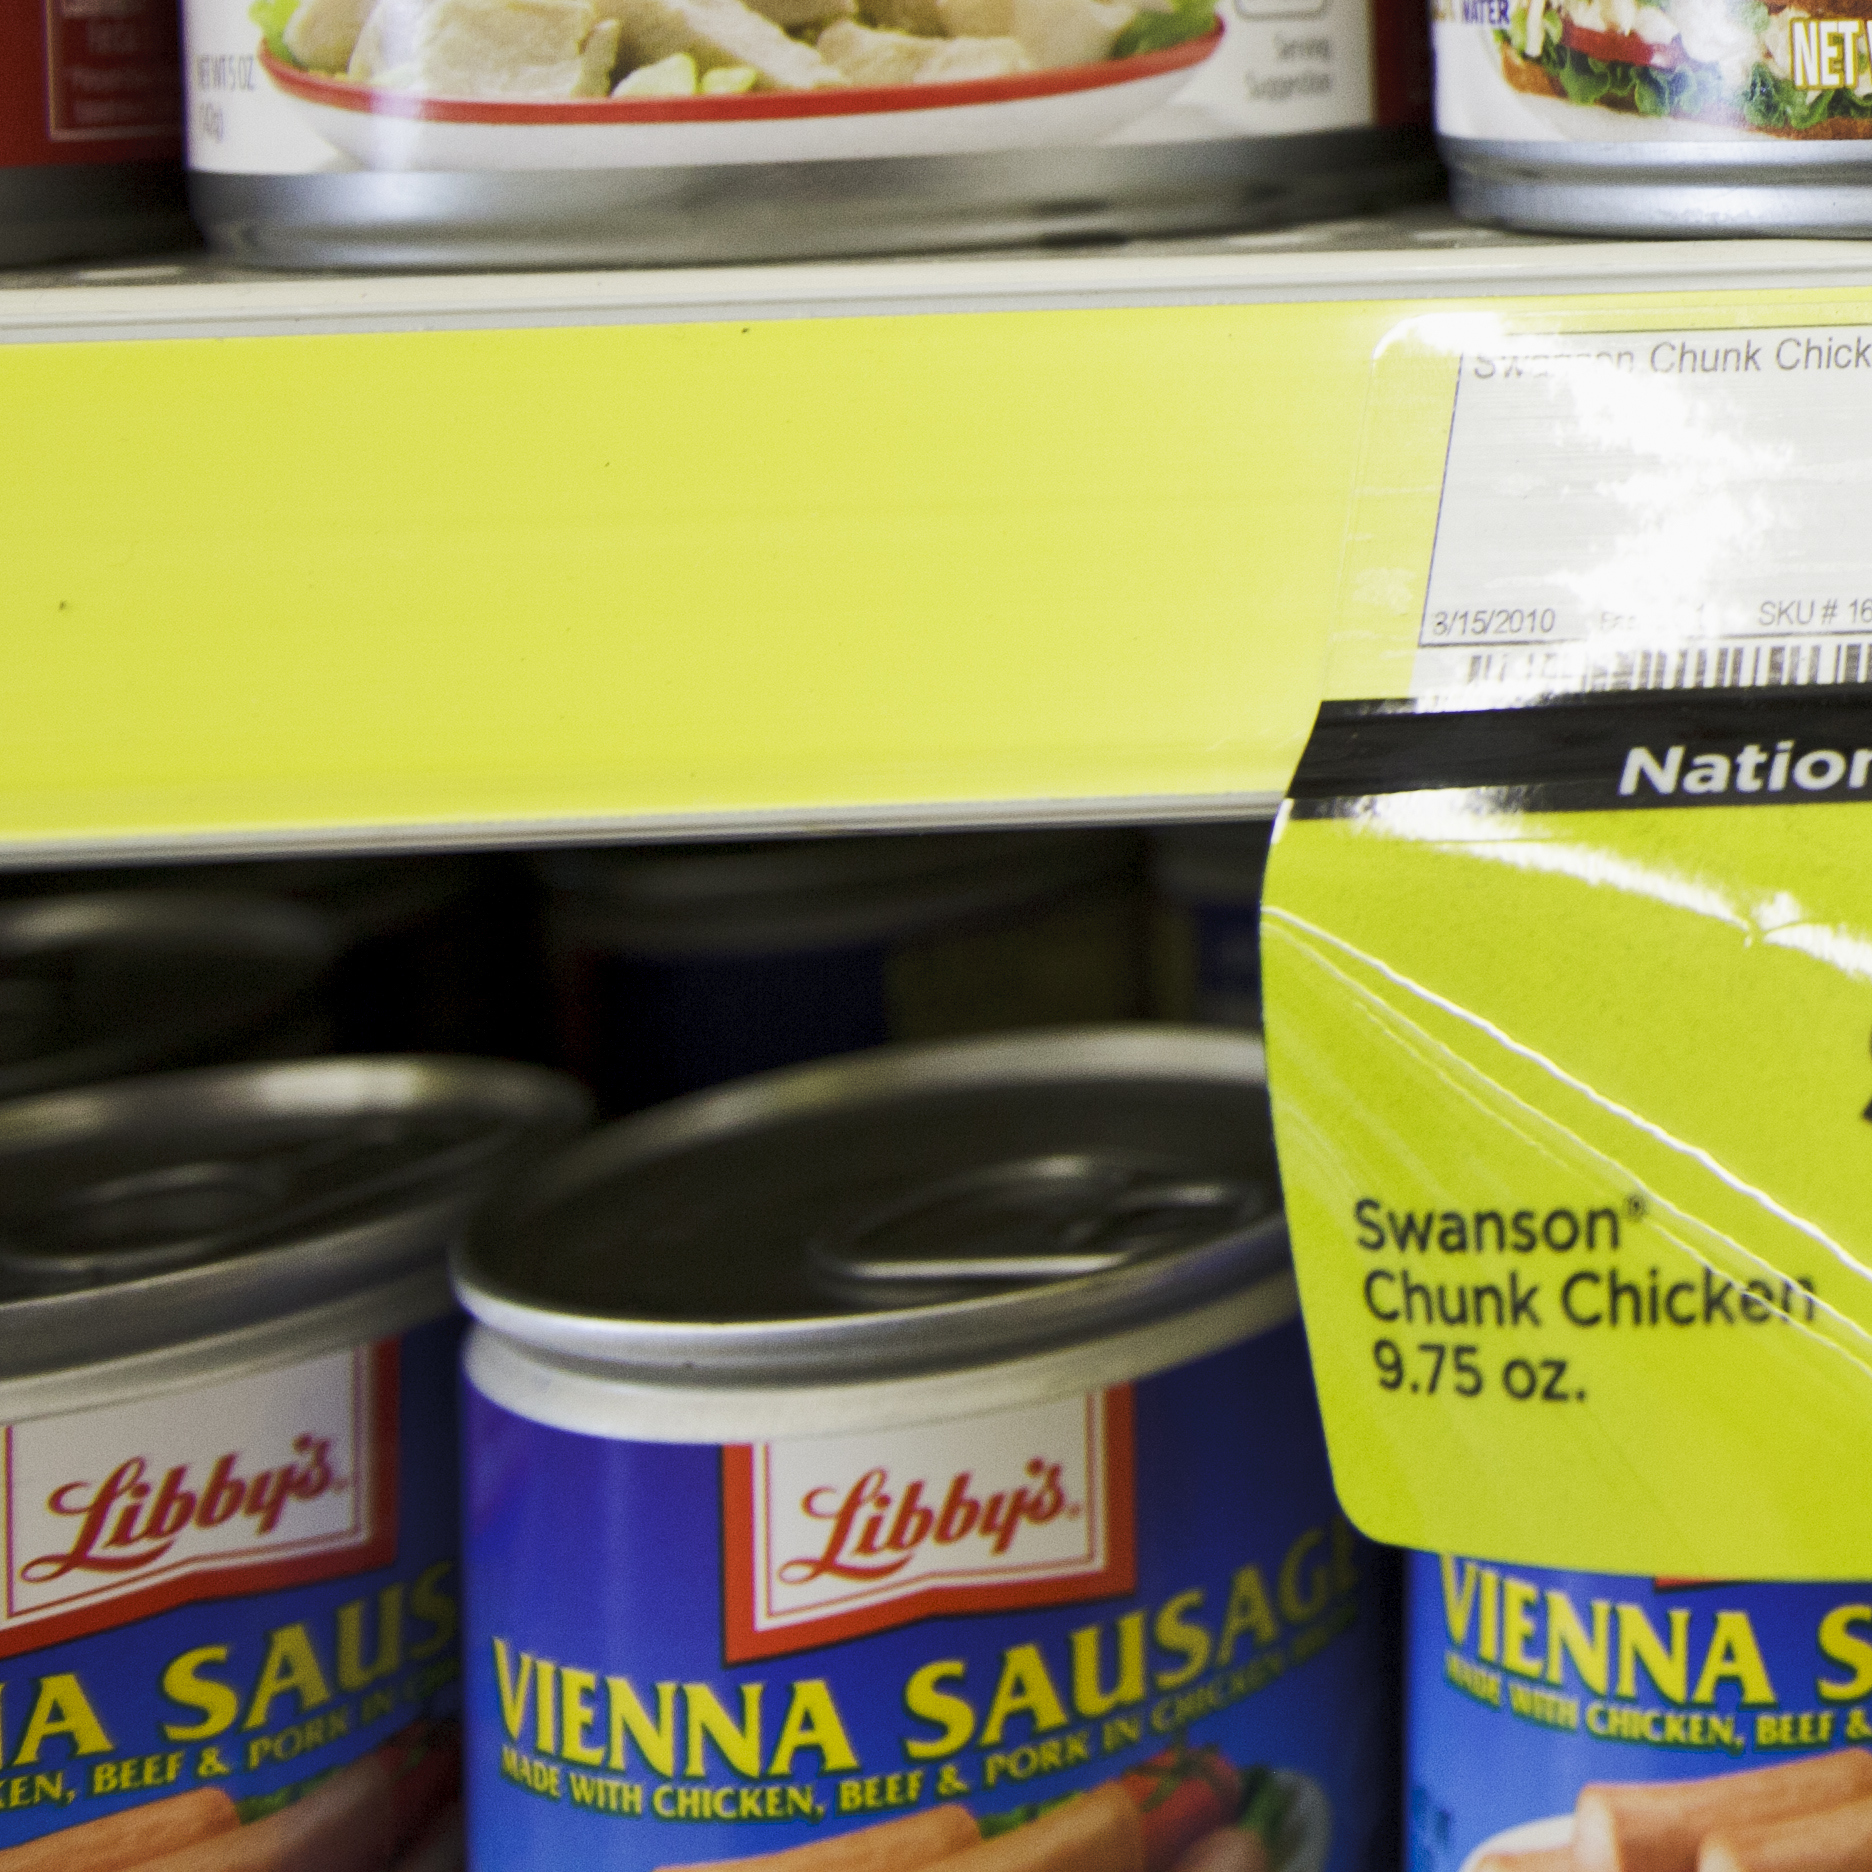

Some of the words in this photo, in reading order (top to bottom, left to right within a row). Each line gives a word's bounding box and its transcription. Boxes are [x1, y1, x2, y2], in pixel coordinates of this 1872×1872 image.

[1790, 17, 1863, 90] NET
[1651, 334, 1766, 377] Chunk
[1432, 607, 1556, 638] 3/15/2010
[1758, 599, 1815, 629] SKU
[1818, 599, 1838, 628] #
[1363, 1269, 1543, 1332] Chunk
[1561, 1269, 1820, 1325] Chicken
[1375, 1345, 1486, 1401] 9.75
[1501, 1356, 1588, 1405] oz.
[1441, 1553, 1776, 1704] VIENNA
[493, 1637, 860, 1777] VIENNA
[572, 1777, 641, 1814] WITH
[653, 1783, 825, 1821] CHICKEN,
[840, 1773, 923, 1812] BEEF
[937, 1764, 970, 1793] &
[985, 1733, 1091, 1788] PORK
